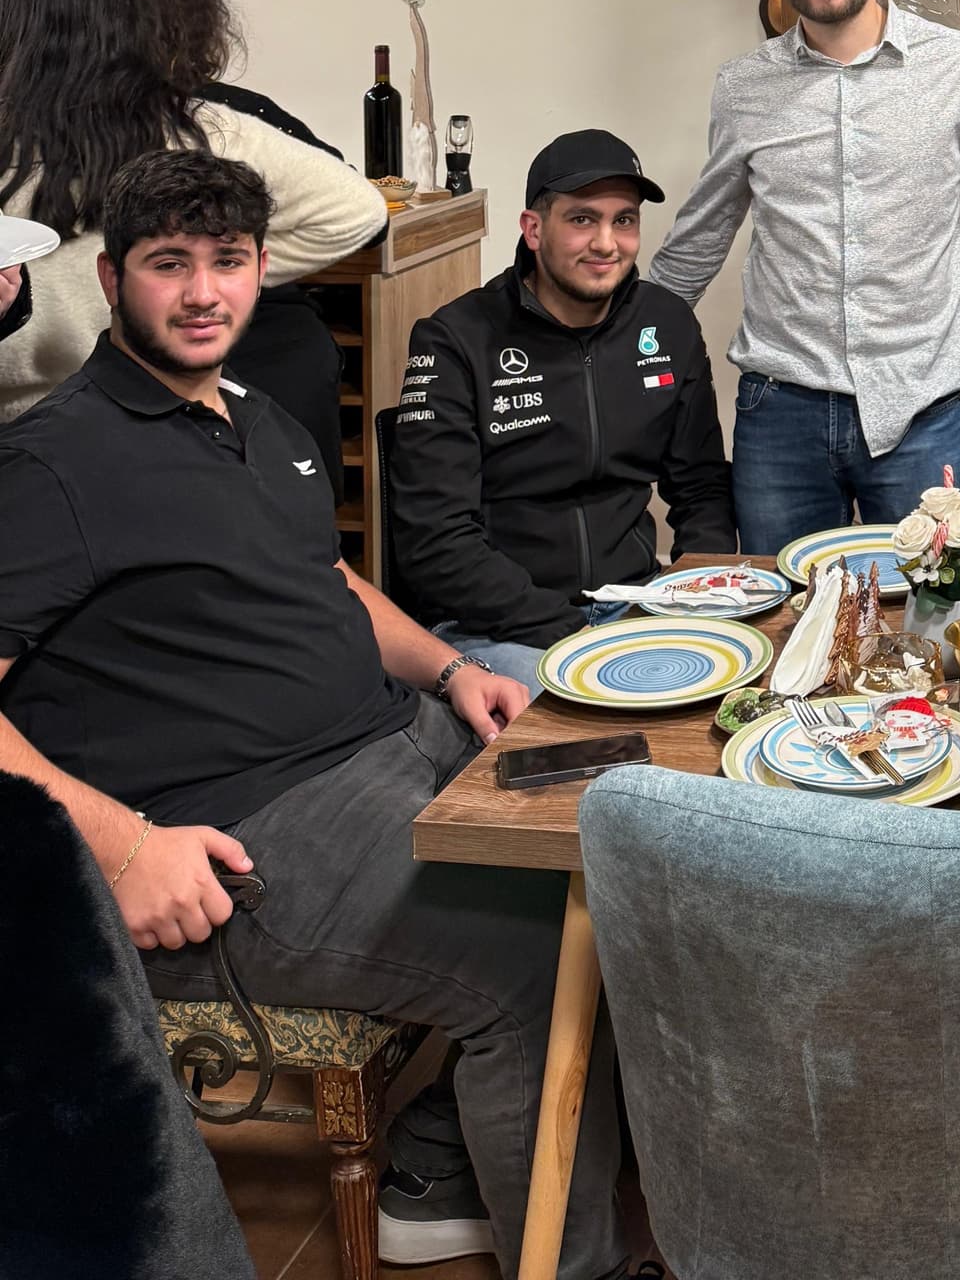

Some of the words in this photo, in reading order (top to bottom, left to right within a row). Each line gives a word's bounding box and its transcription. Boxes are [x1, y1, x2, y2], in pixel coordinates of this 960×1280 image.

[636, 355, 671, 367] PETRONAS
[512, 391, 543, 409] UBS
[490, 414, 551, 434] Qualcomm
